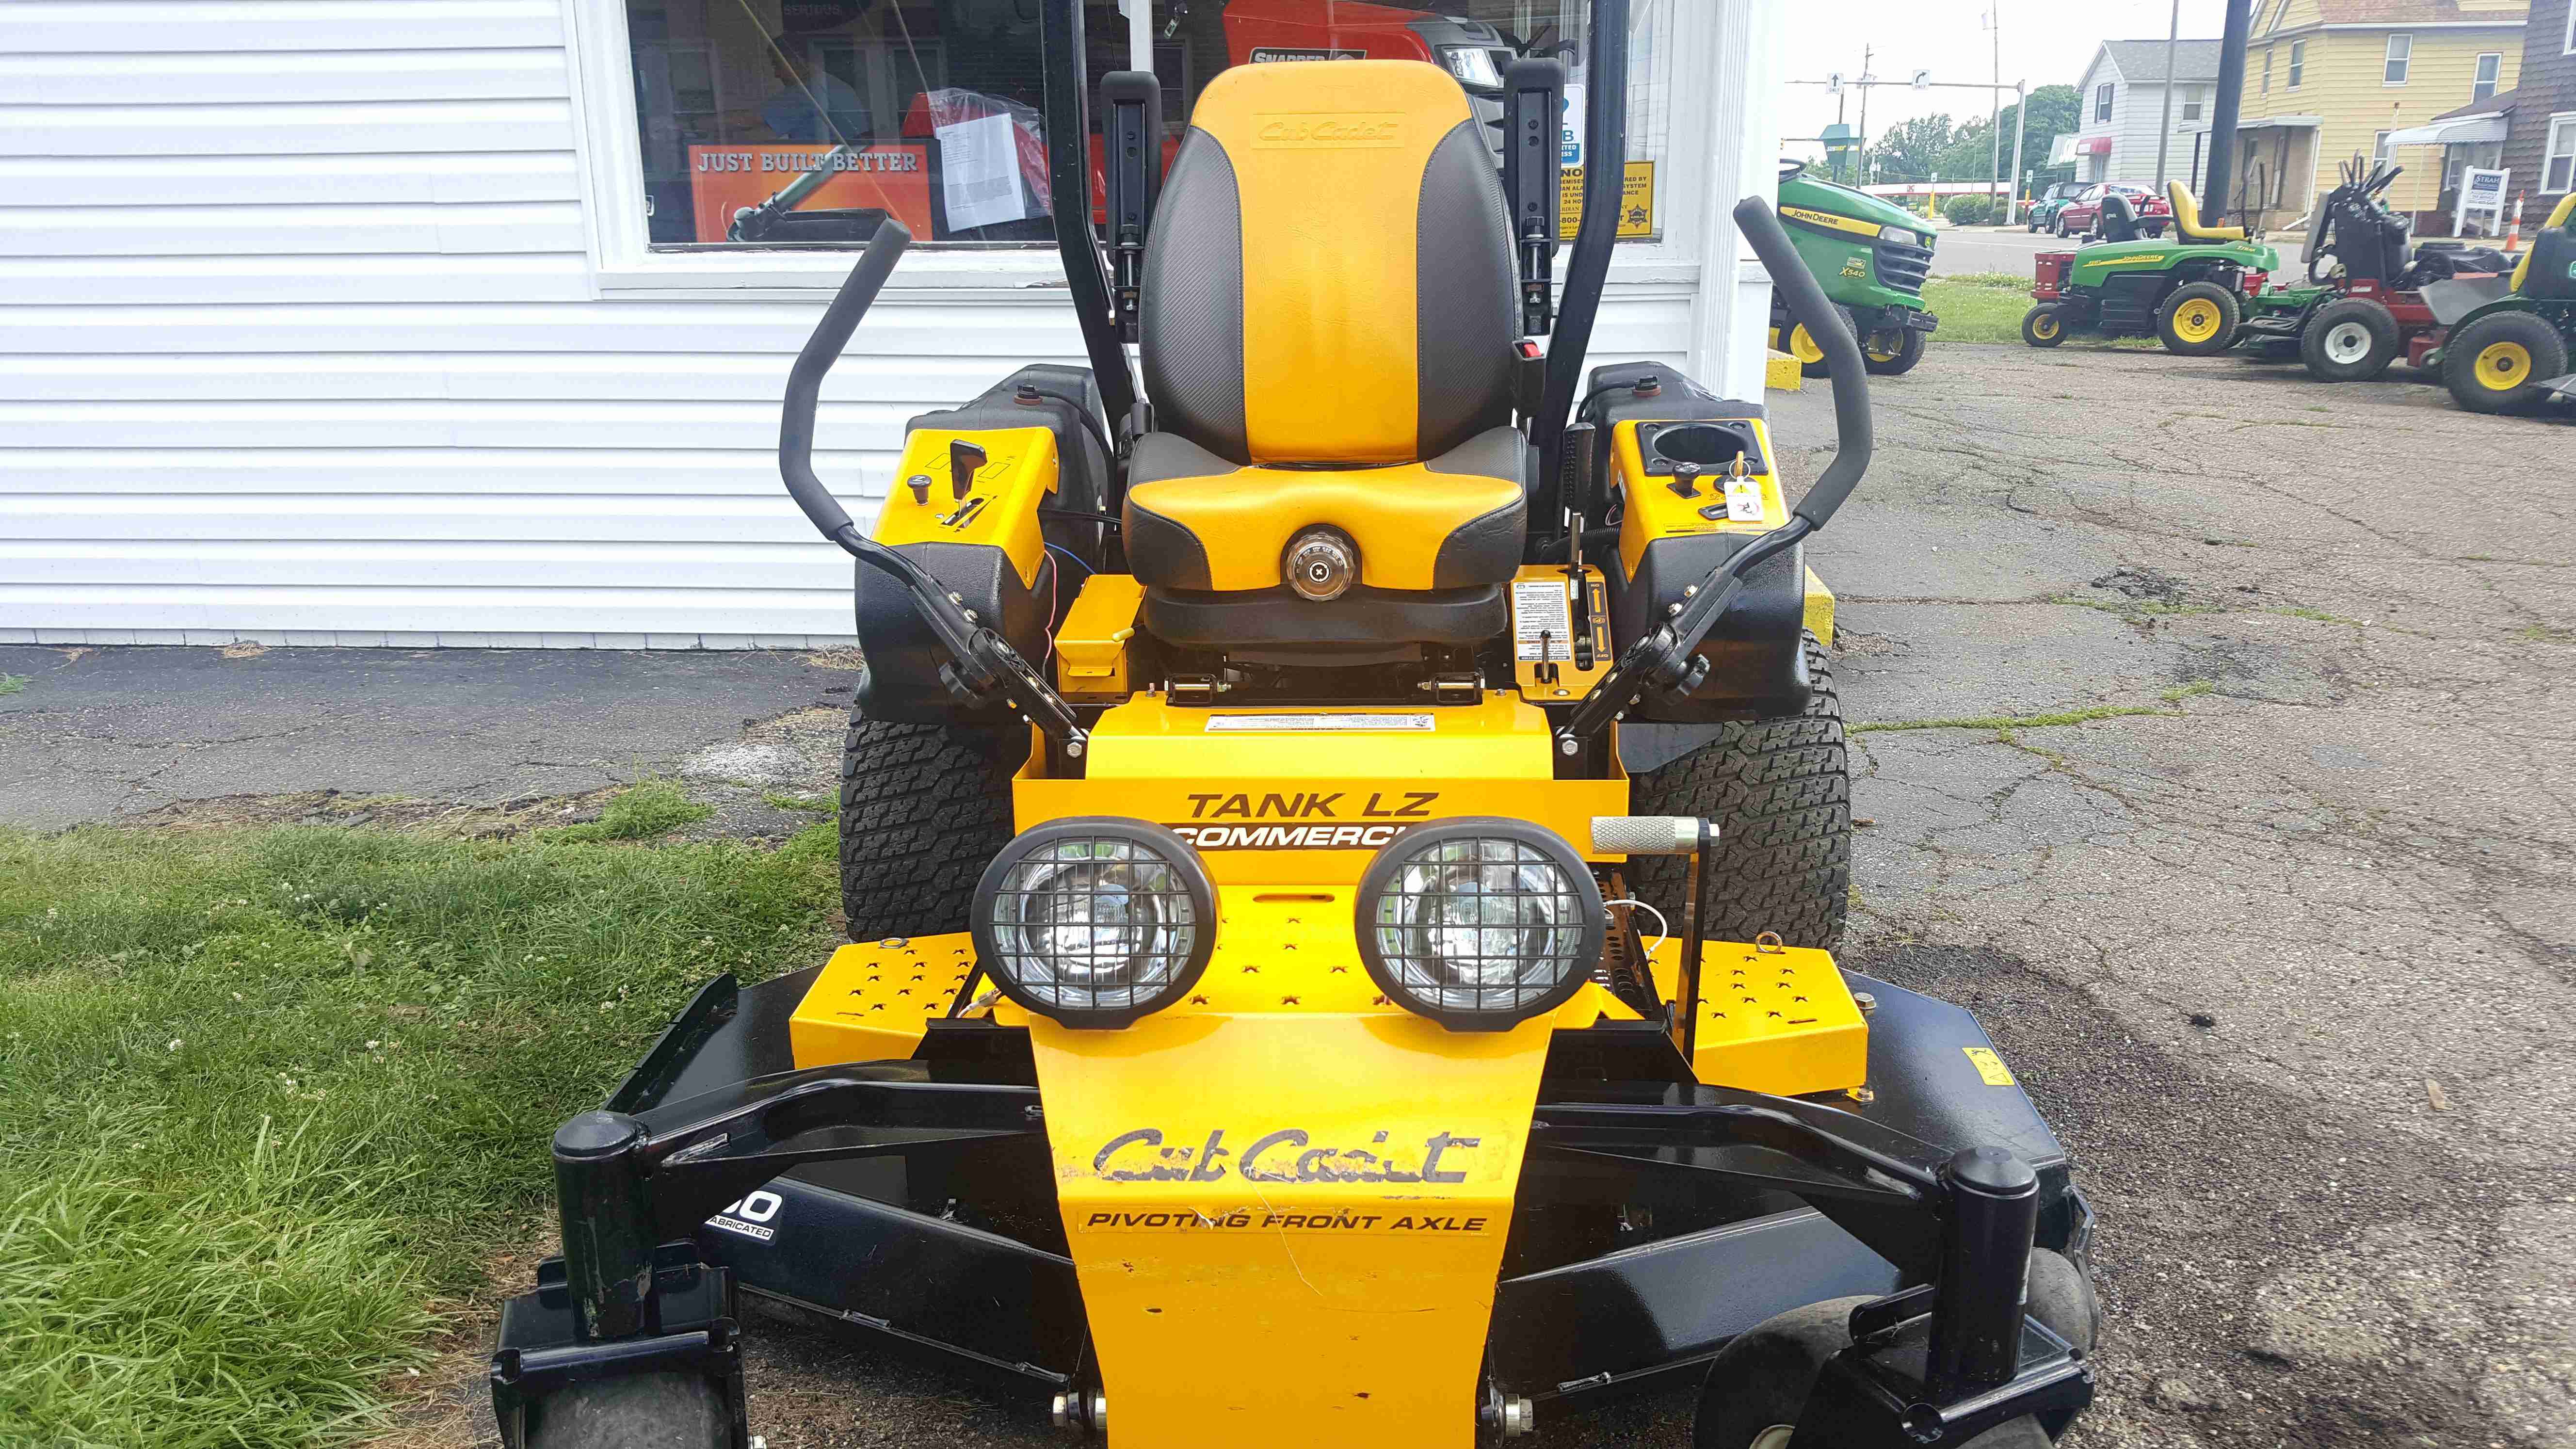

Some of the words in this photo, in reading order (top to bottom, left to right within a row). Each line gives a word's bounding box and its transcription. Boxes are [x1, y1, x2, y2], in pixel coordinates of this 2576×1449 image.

[698, 153, 753, 172] JUST
[760, 153, 825, 172] BUILT
[832, 153, 918, 172] BETTER
[1791, 209, 1813, 220] JOHN
[1813, 213, 1839, 225] DEERE
[1838, 266, 1866, 278] X540
[1187, 793, 1346, 818] TANK
[1361, 792, 1440, 817] LZ
[1093, 1128, 1229, 1182] Cub
[709, 1216, 772, 1238] ABRICATED
[1261, 1214, 1382, 1229] FRONT
[1389, 1216, 1487, 1231] AXLE
